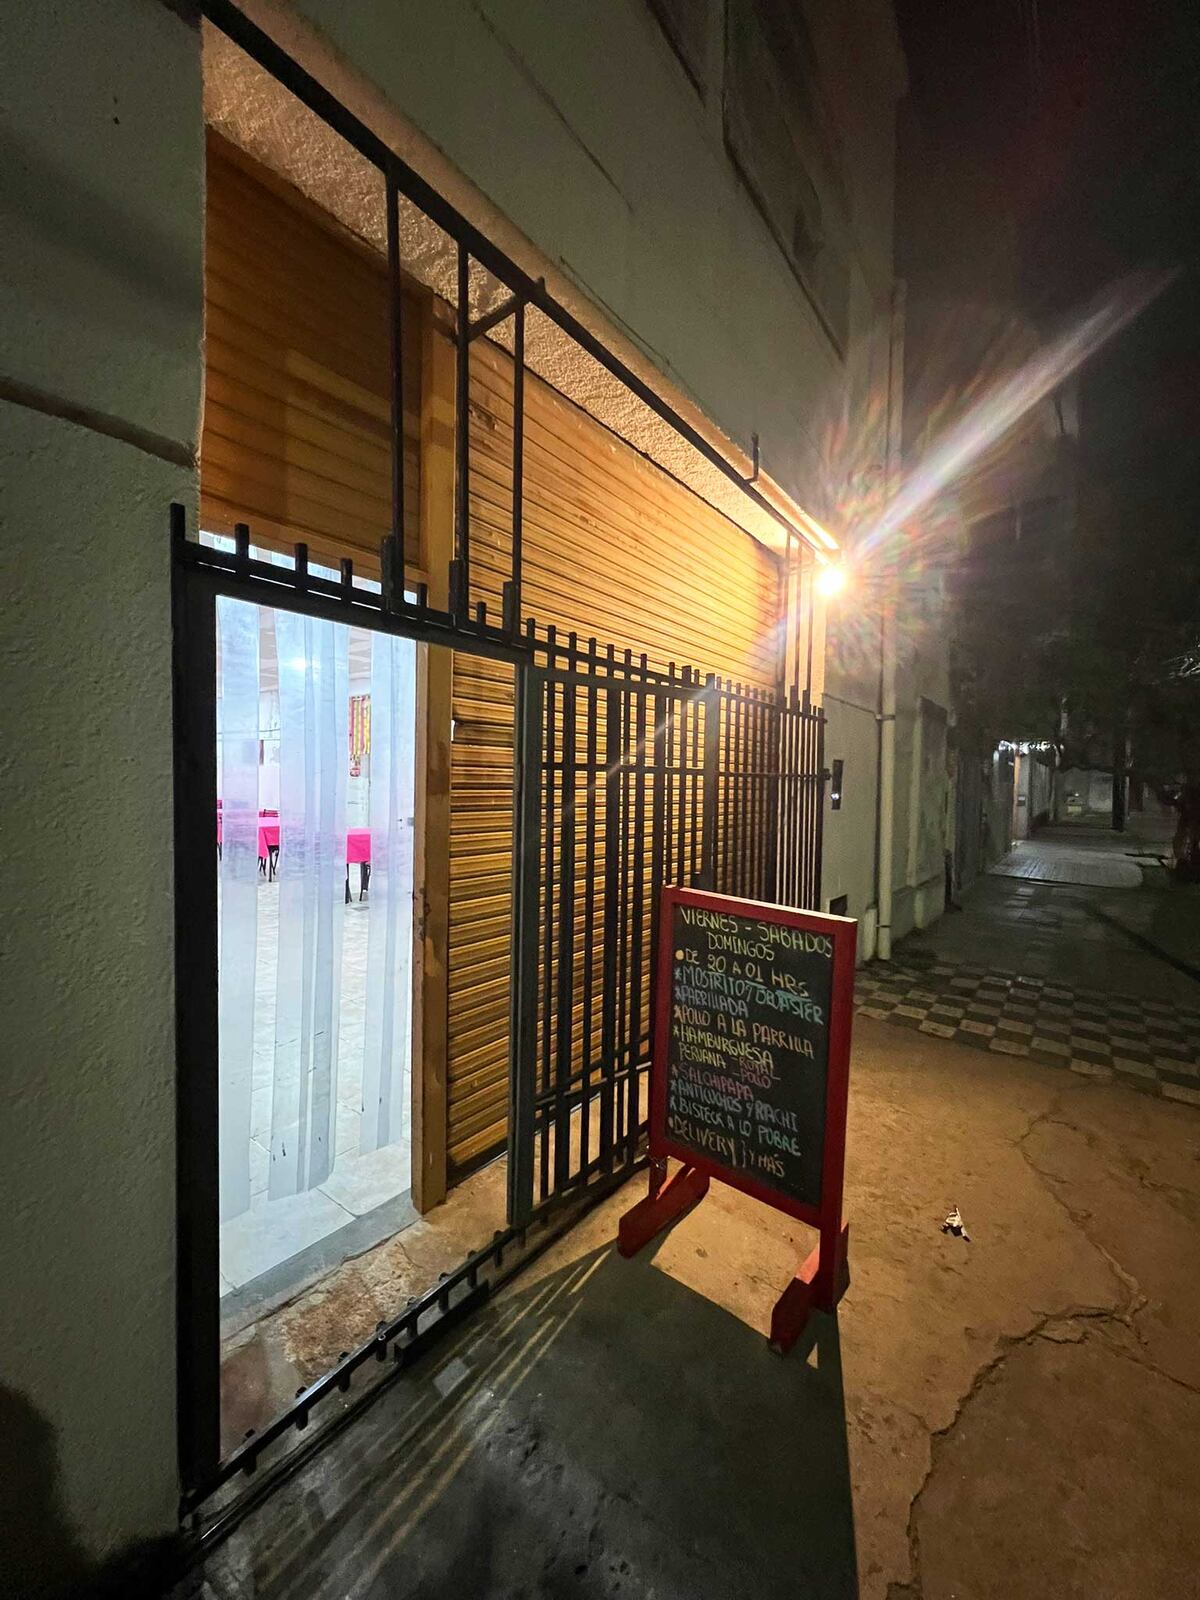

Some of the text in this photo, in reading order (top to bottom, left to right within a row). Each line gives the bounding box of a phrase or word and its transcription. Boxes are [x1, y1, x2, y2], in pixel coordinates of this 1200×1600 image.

[680, 906, 738, 933] VIERNES
[757, 922, 833, 958] SABADOS
[706, 932, 775, 961] DOMINGOS
[685, 948, 809, 997] DE 20 A 01 HRS
[680, 985, 749, 1019] PARRILLADA
[679, 1042, 726, 1069] PERUANA
[681, 1025, 774, 1069] HAMBURGUESA
[717, 1013, 727, 1033] A
[731, 1017, 747, 1037] LA
[753, 1023, 815, 1059] PARRILLA
[674, 1114, 737, 1168] DELIVERY
[727, 1116, 735, 1131] A
[738, 1120, 751, 1138] LO
[758, 1126, 801, 1156] POBRE
